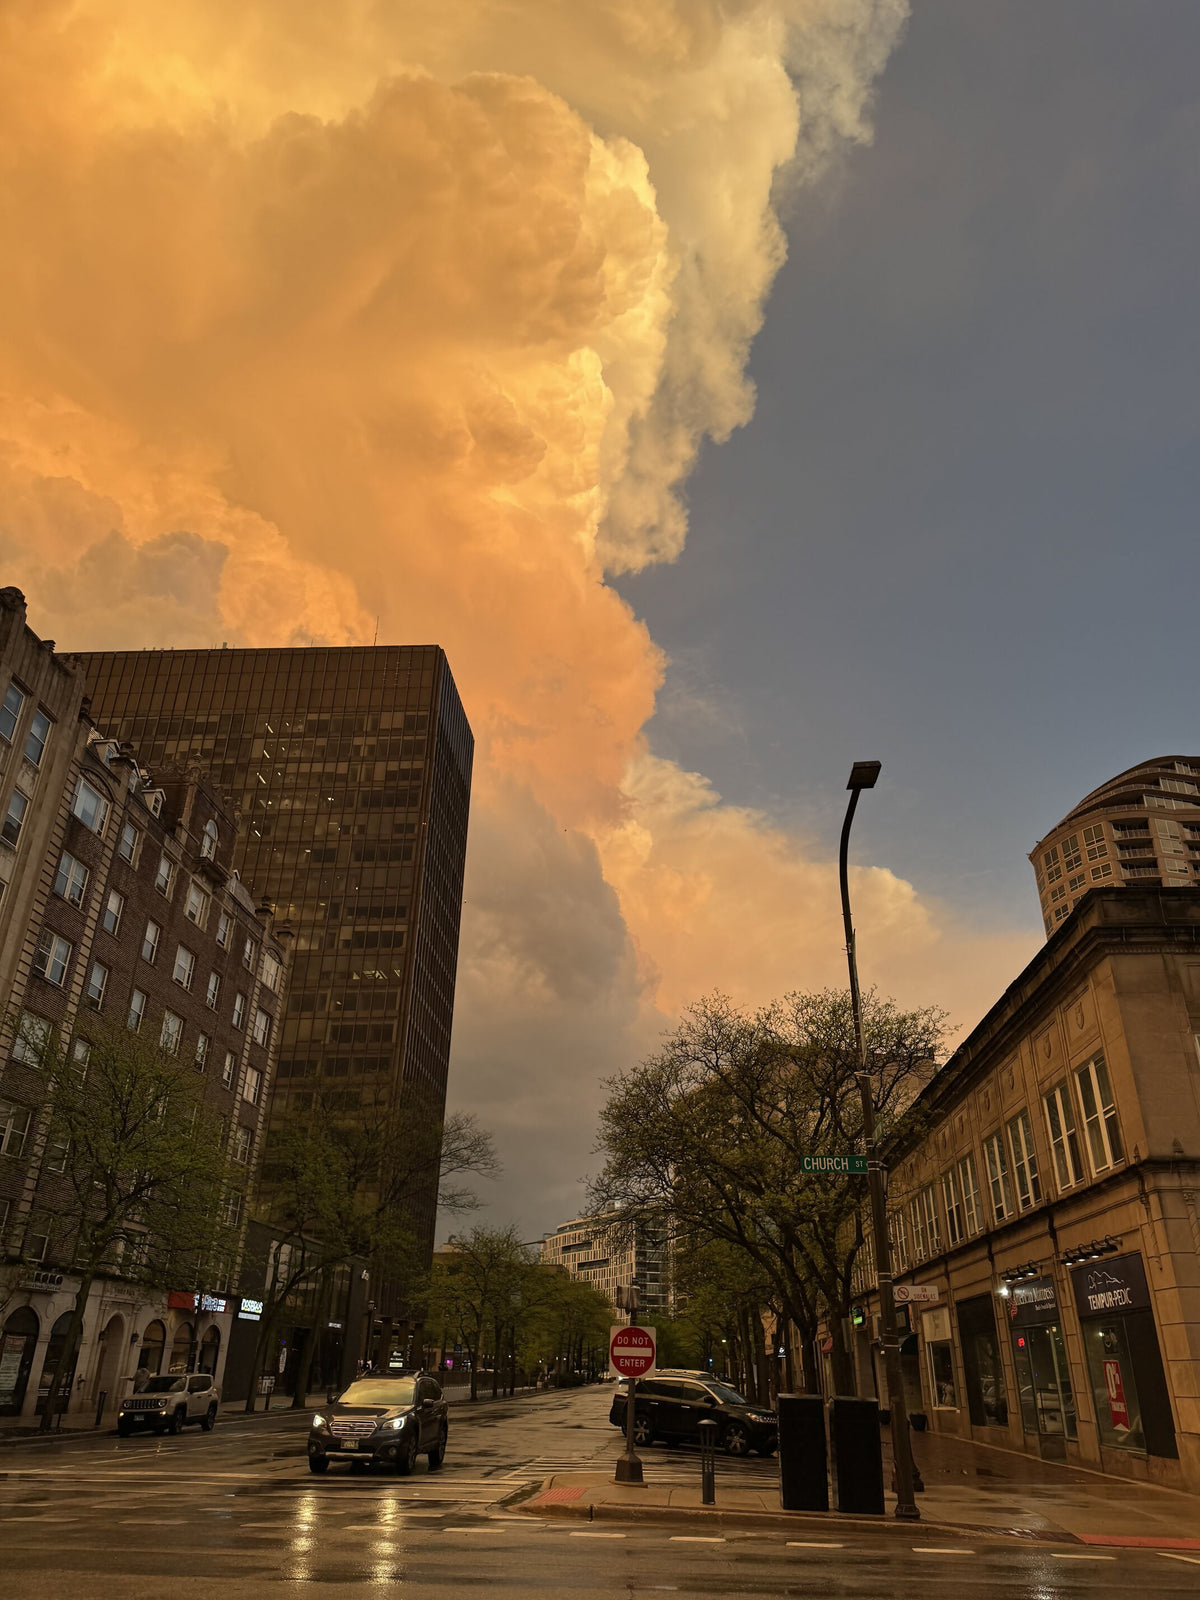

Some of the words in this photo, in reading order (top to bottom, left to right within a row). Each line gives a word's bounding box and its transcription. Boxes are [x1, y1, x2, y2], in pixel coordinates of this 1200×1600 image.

[803, 1157, 849, 1171] CHURCH
[1087, 1287, 1133, 1311] TEMPUR-PEDIC
[617, 1336, 629, 1345] DO
[631, 1336, 649, 1346] NOT
[619, 1358, 646, 1368] ENTER
